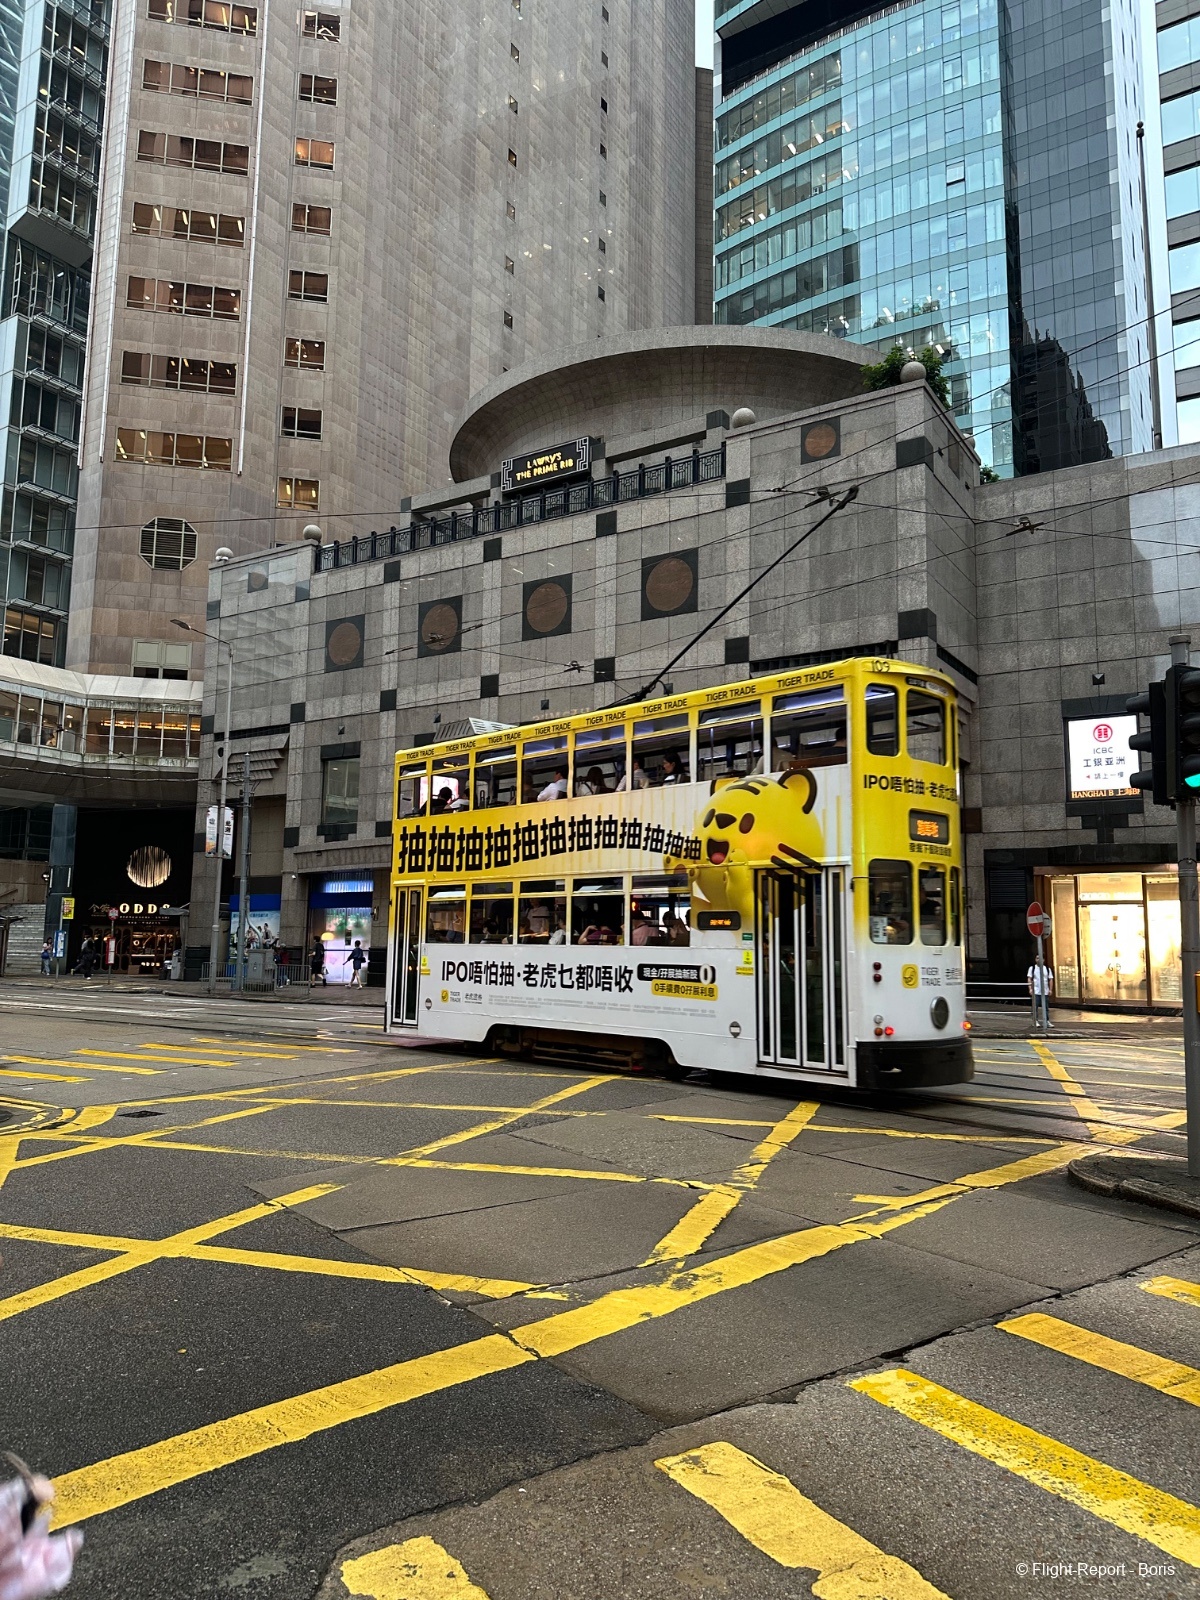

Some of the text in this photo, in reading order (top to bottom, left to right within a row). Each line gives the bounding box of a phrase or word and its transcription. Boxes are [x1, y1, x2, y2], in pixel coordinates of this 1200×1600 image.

[527, 452, 562, 469] LAWRY'S
[516, 458, 574, 481] THE PRIME RIB
[871, 659, 890, 672] 109
[776, 669, 835, 688] TIGER TRADE
[705, 685, 757, 702] TIGER TRADE
[642, 698, 688, 714] TIGER TRADE
[585, 711, 626, 725] TIGER TRADE
[534, 722, 571, 735] TIGER TRADE
[460, 741, 477, 749] TRADE
[488, 732, 521, 744] TIGER TRADE
[1093, 746, 1114, 754] ICBC
